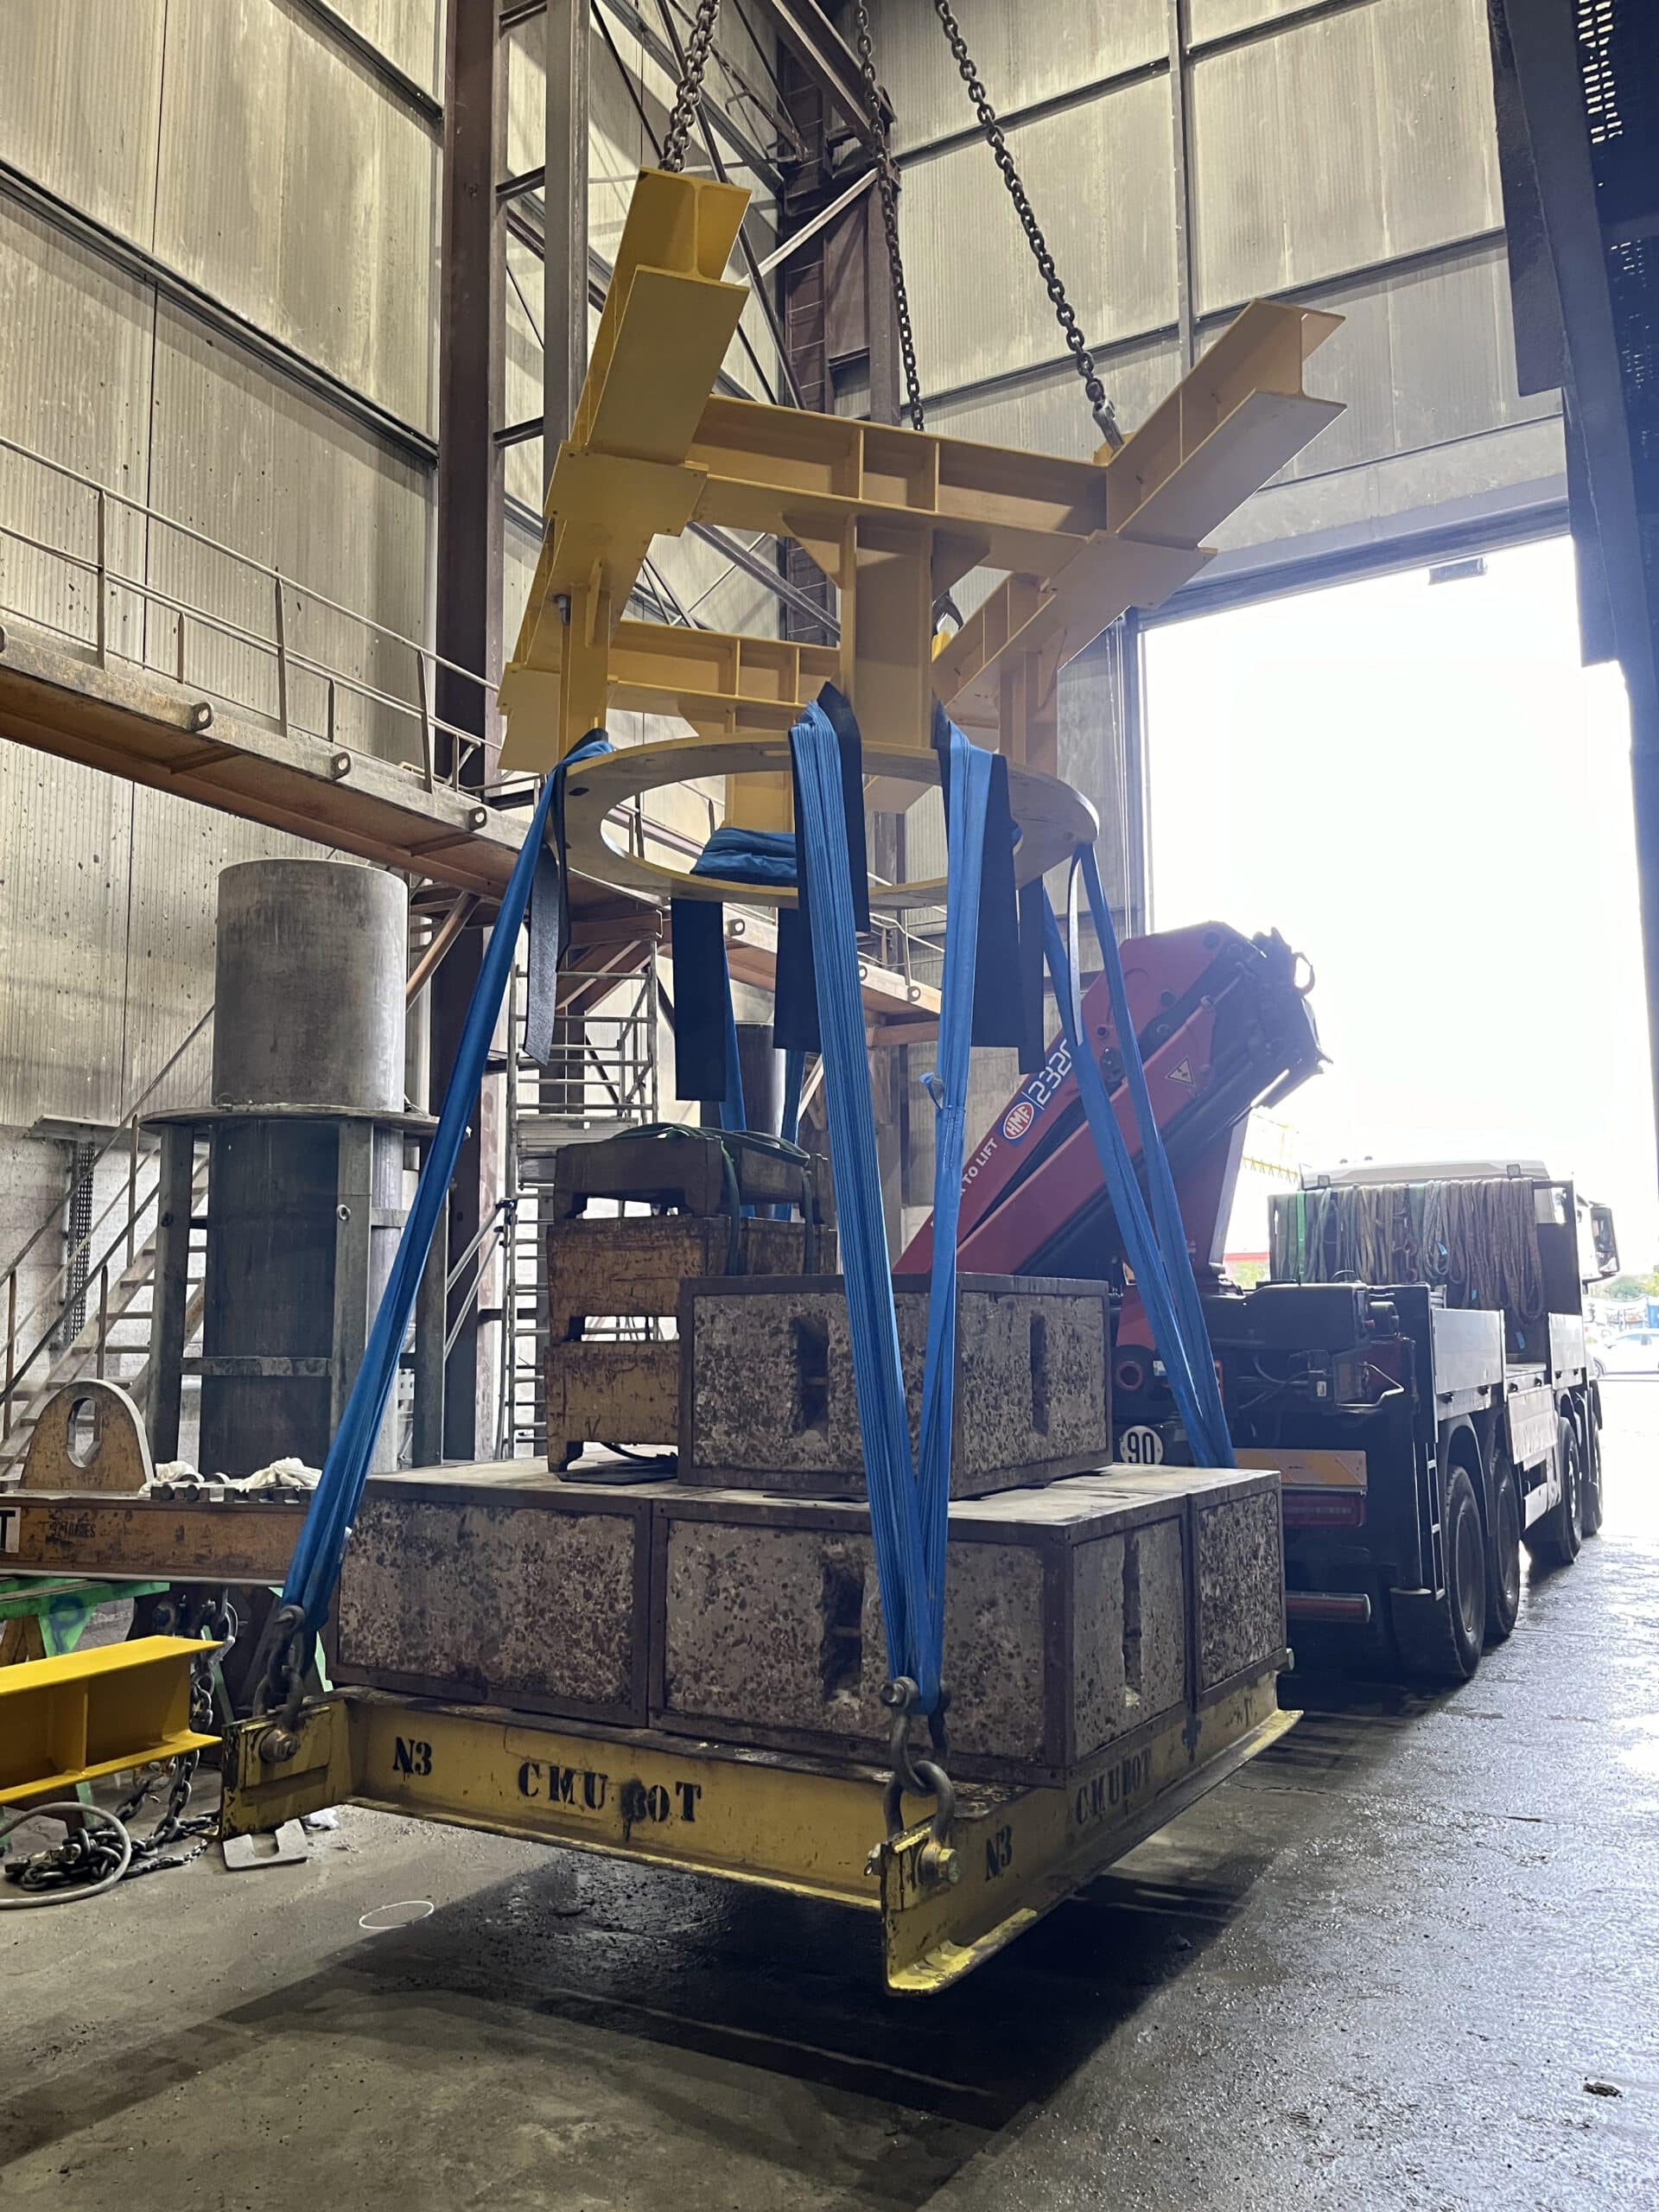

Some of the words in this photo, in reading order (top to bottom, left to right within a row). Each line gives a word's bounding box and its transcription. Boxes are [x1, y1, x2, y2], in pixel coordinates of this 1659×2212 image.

[1005, 1104, 1032, 1136] HMF
[975, 1137, 998, 1167] LIFT
[1127, 1431, 1155, 1464] 90
[392, 1736, 432, 1777] N3
[518, 1762, 608, 1809] CMU
[1076, 1765, 1121, 1825] CMU
[985, 1824, 1013, 1881] N3
